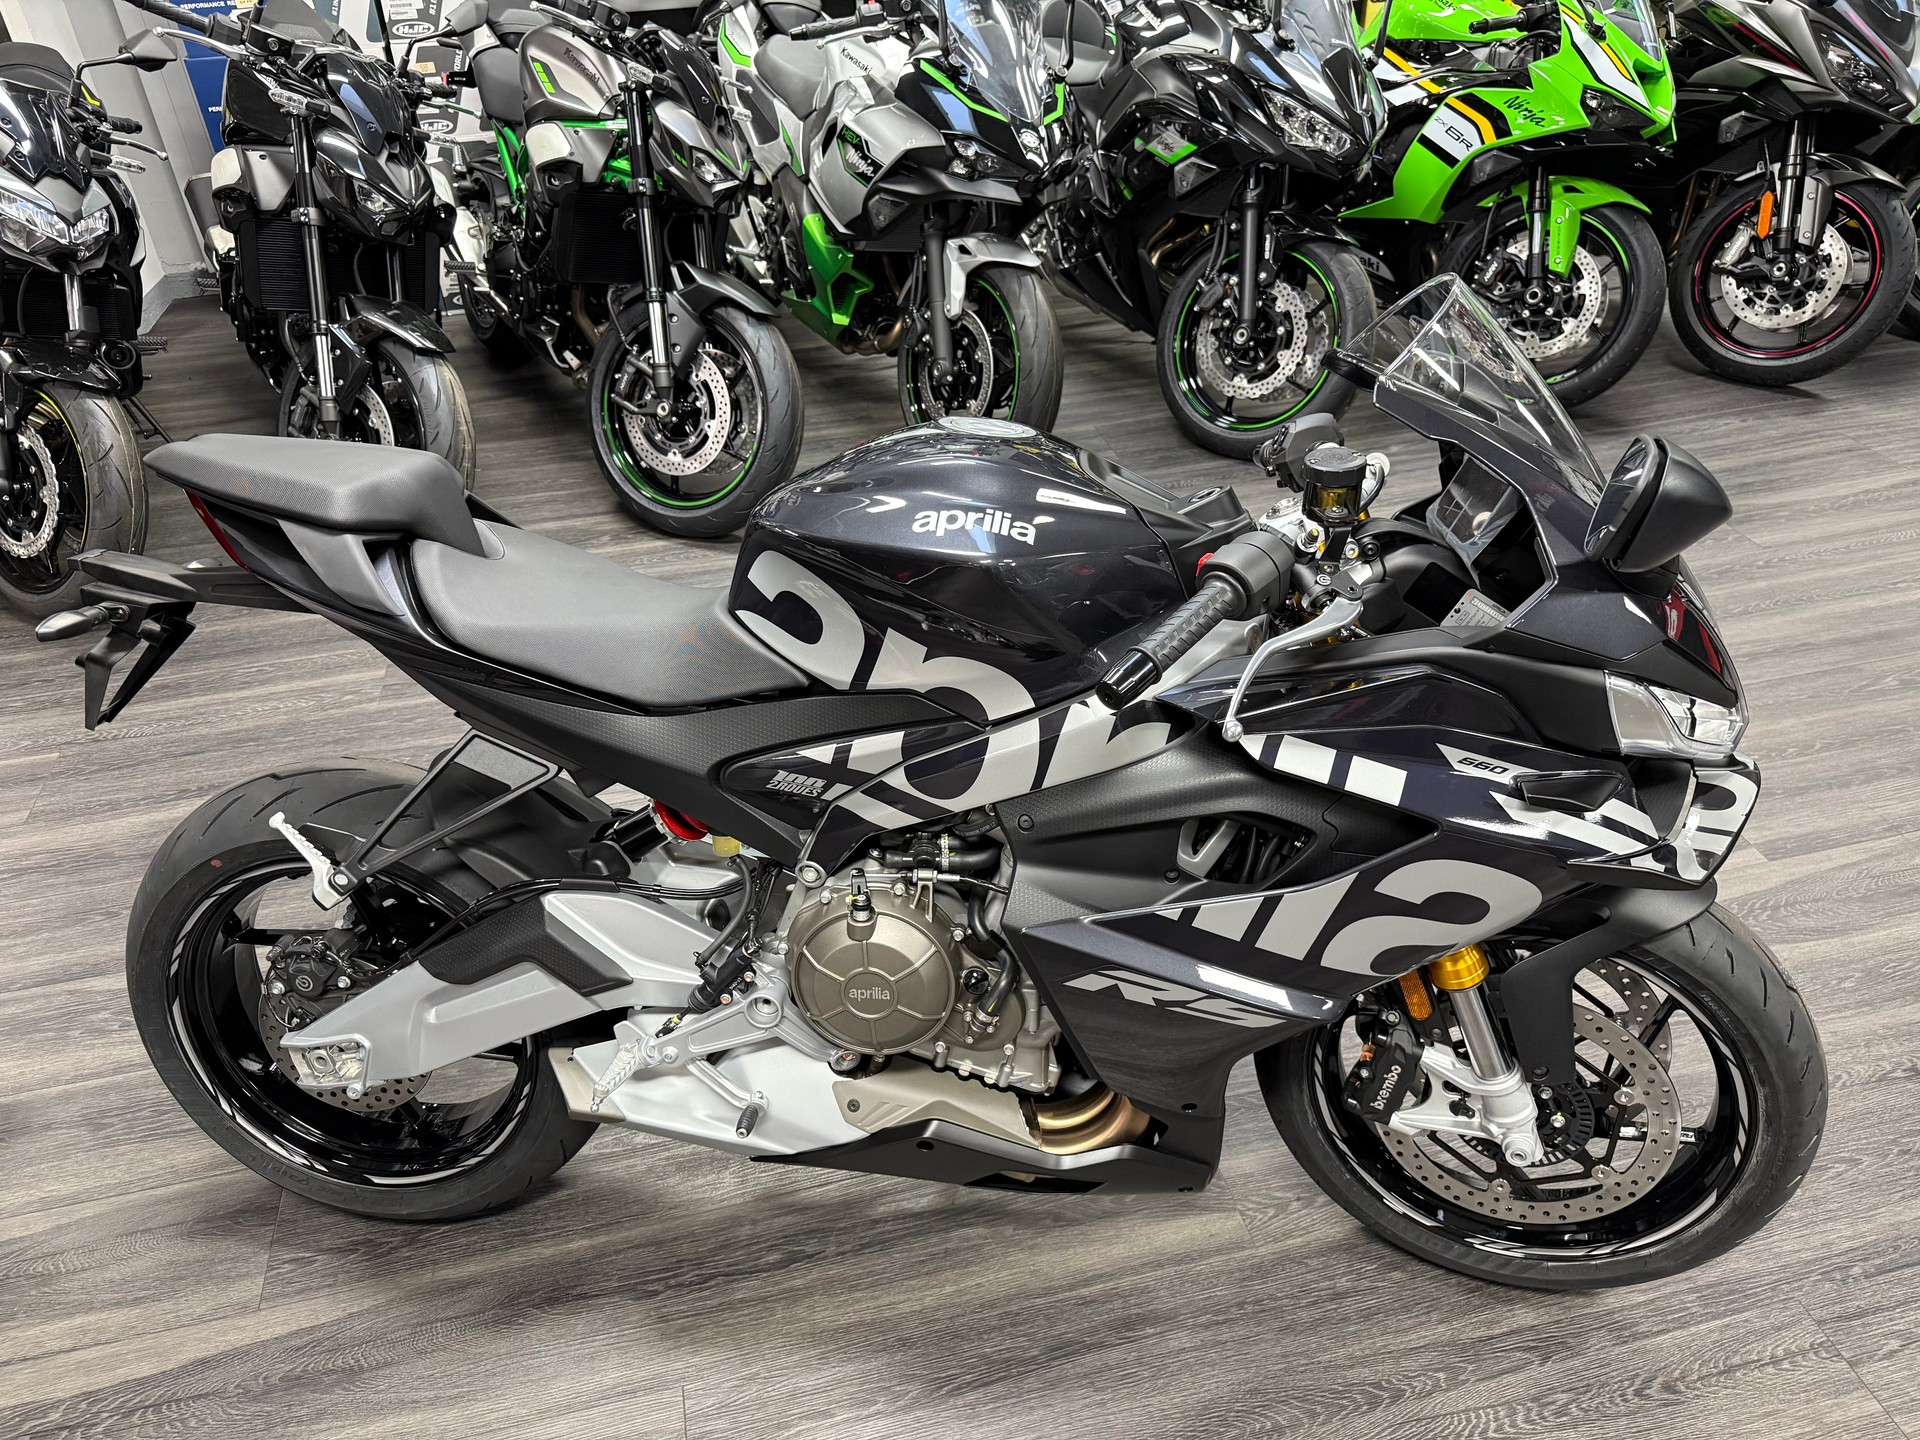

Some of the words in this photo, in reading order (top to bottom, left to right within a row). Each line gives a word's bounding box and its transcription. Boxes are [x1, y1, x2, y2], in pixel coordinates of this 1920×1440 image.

[180, 1, 225, 10] PERFORMANCE
[399, 25, 429, 34] HJC
[563, 47, 600, 85] Kawasaki
[841, 46, 873, 75] Kawasaki
[1503, 96, 1546, 127] Ninja
[420, 123, 448, 131] HJC
[841, 127, 860, 144] HEV
[845, 148, 875, 177] Ninja
[912, 508, 1037, 545] aprilia
[1457, 757, 1510, 774] 660
[848, 986, 890, 1001] aprilia
[1062, 970, 1287, 1028] RS
[1369, 1065, 1402, 1111] brembo
